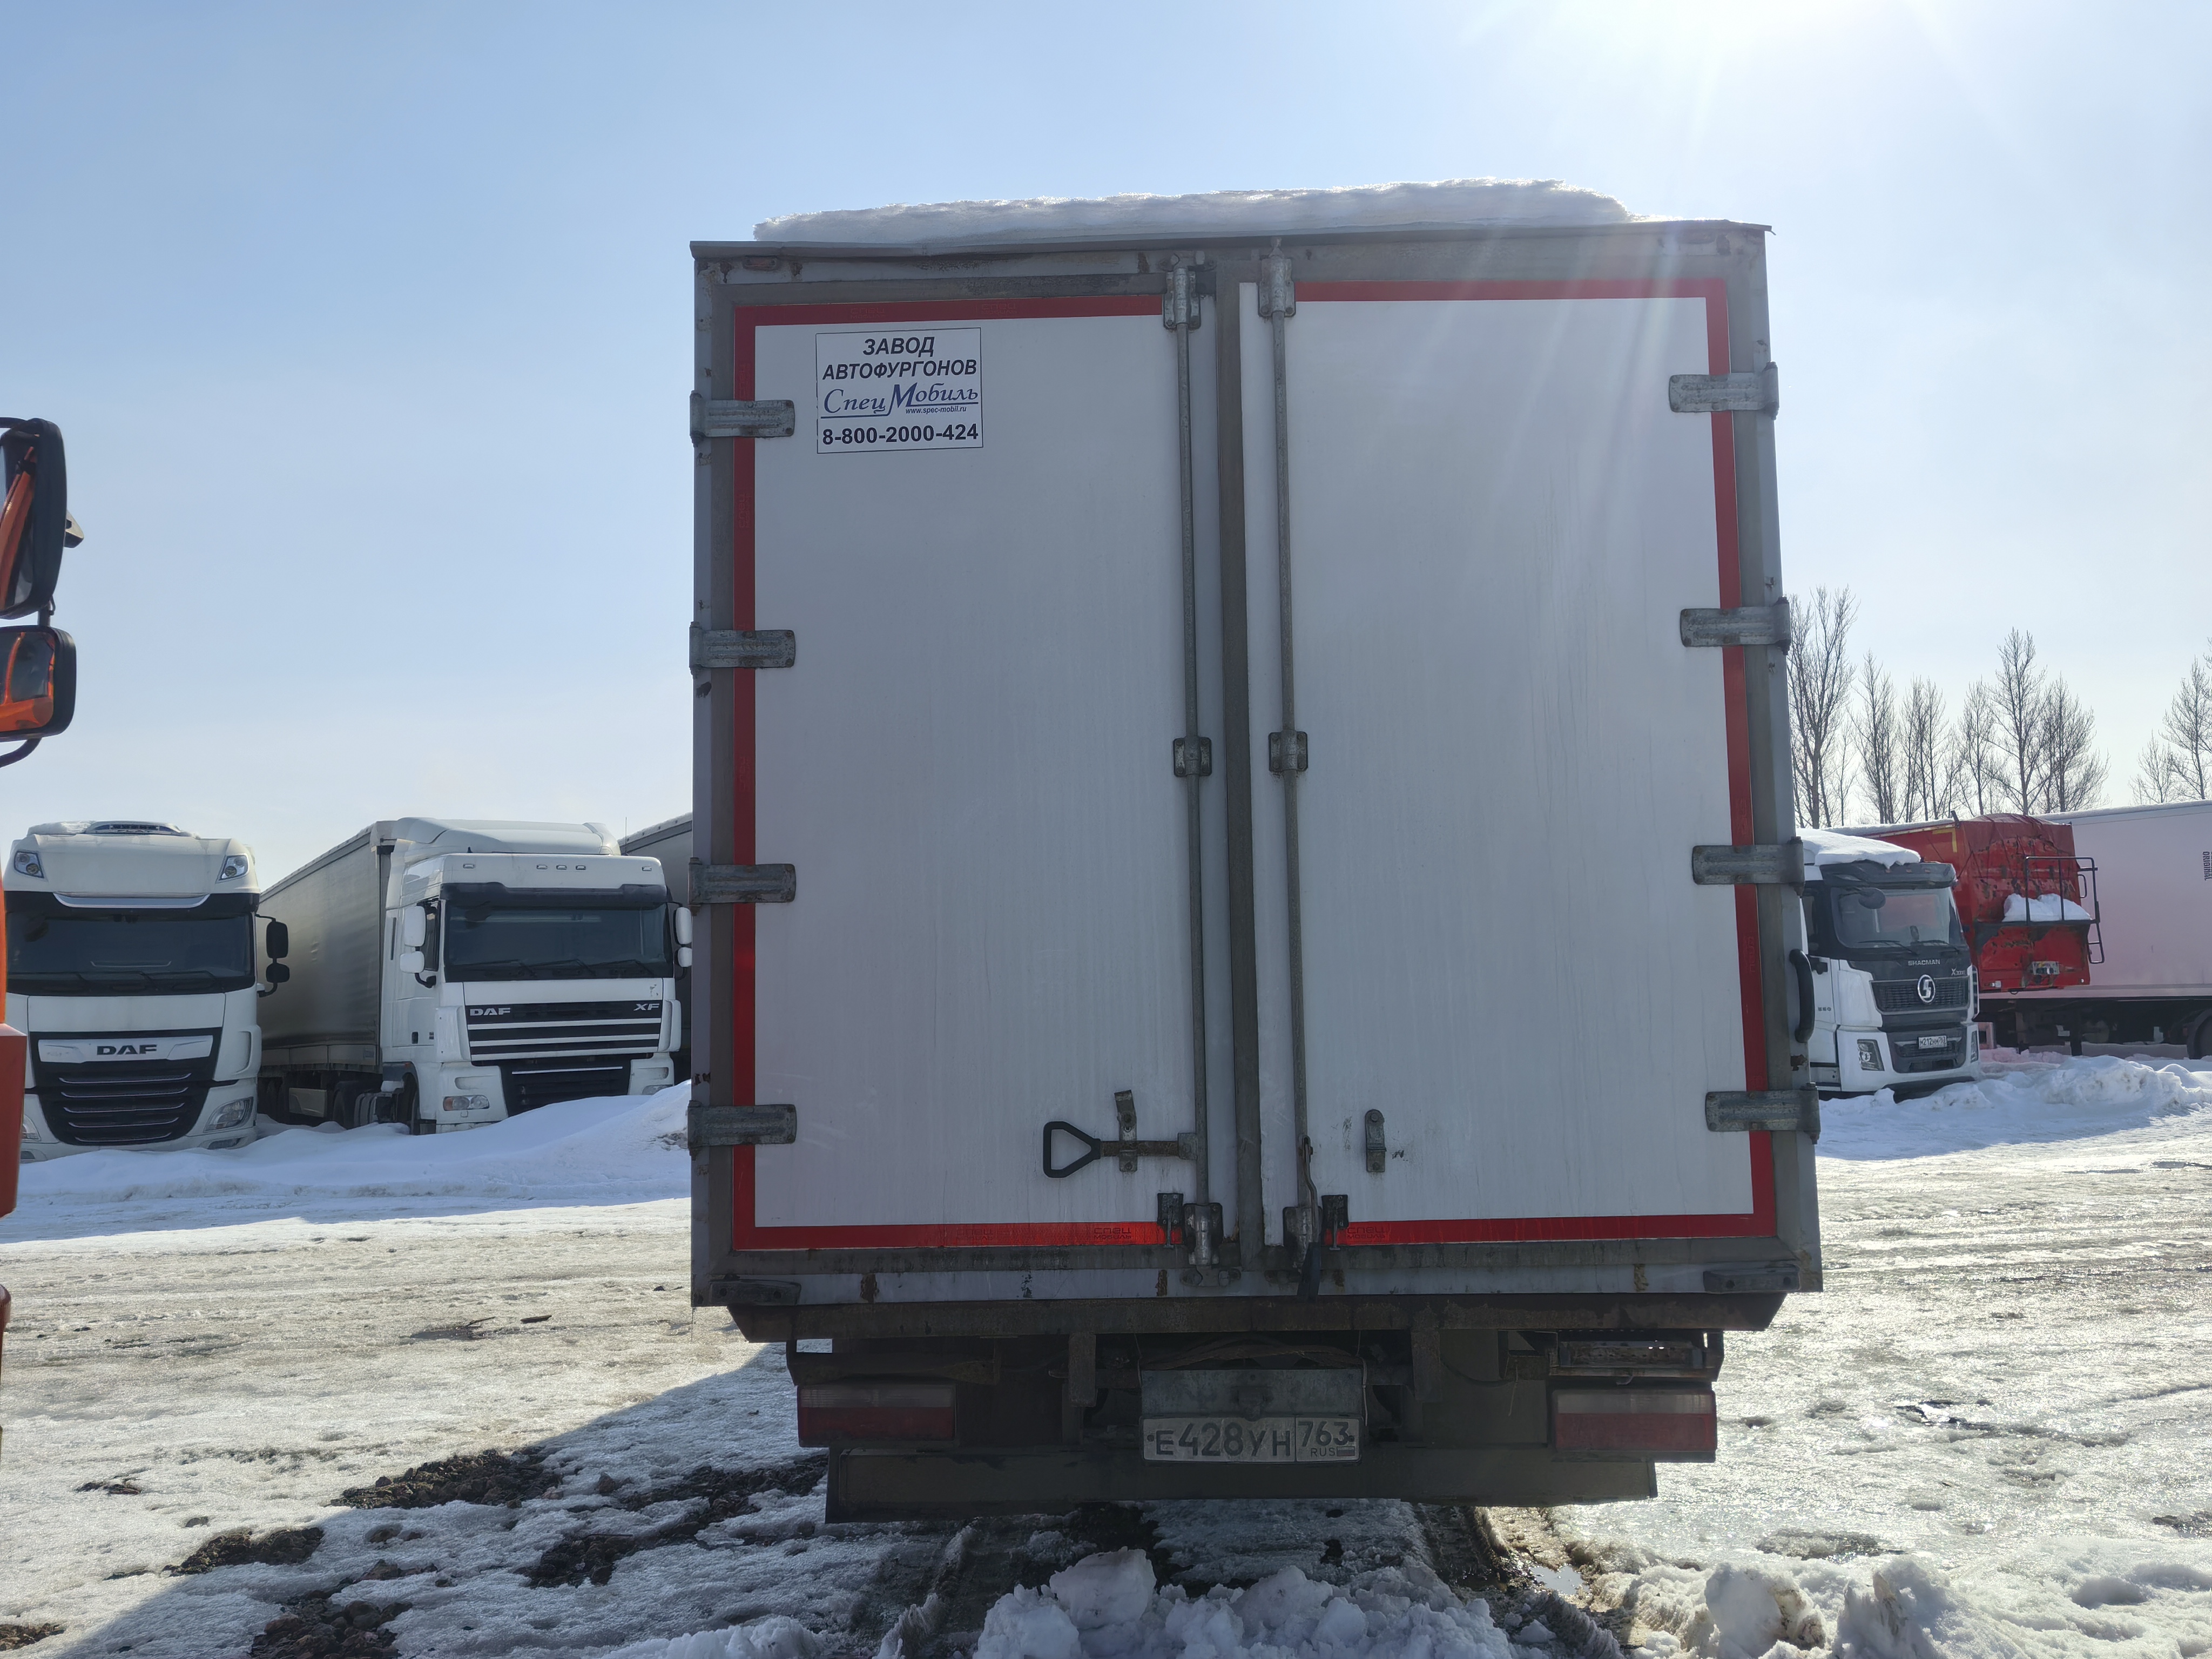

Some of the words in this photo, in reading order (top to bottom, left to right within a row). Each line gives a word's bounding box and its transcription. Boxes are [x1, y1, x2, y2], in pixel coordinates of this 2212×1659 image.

[863, 337, 935, 358] ЗАВОД
[822, 359, 977, 380] АВТОФУРГОНОВ
[905, 406, 967, 415] www.spec-mobil.ru
[822, 423, 979, 445] 8-800-2000-424
[470, 1007, 511, 1016] DAF
[633, 1003, 660, 1011] XF
[97, 1044, 157, 1055] DAF
[1155, 1422, 1291, 1457] Е428УН
[1298, 1421, 1350, 1447] 763
[1311, 1447, 1336, 1456] RUS
